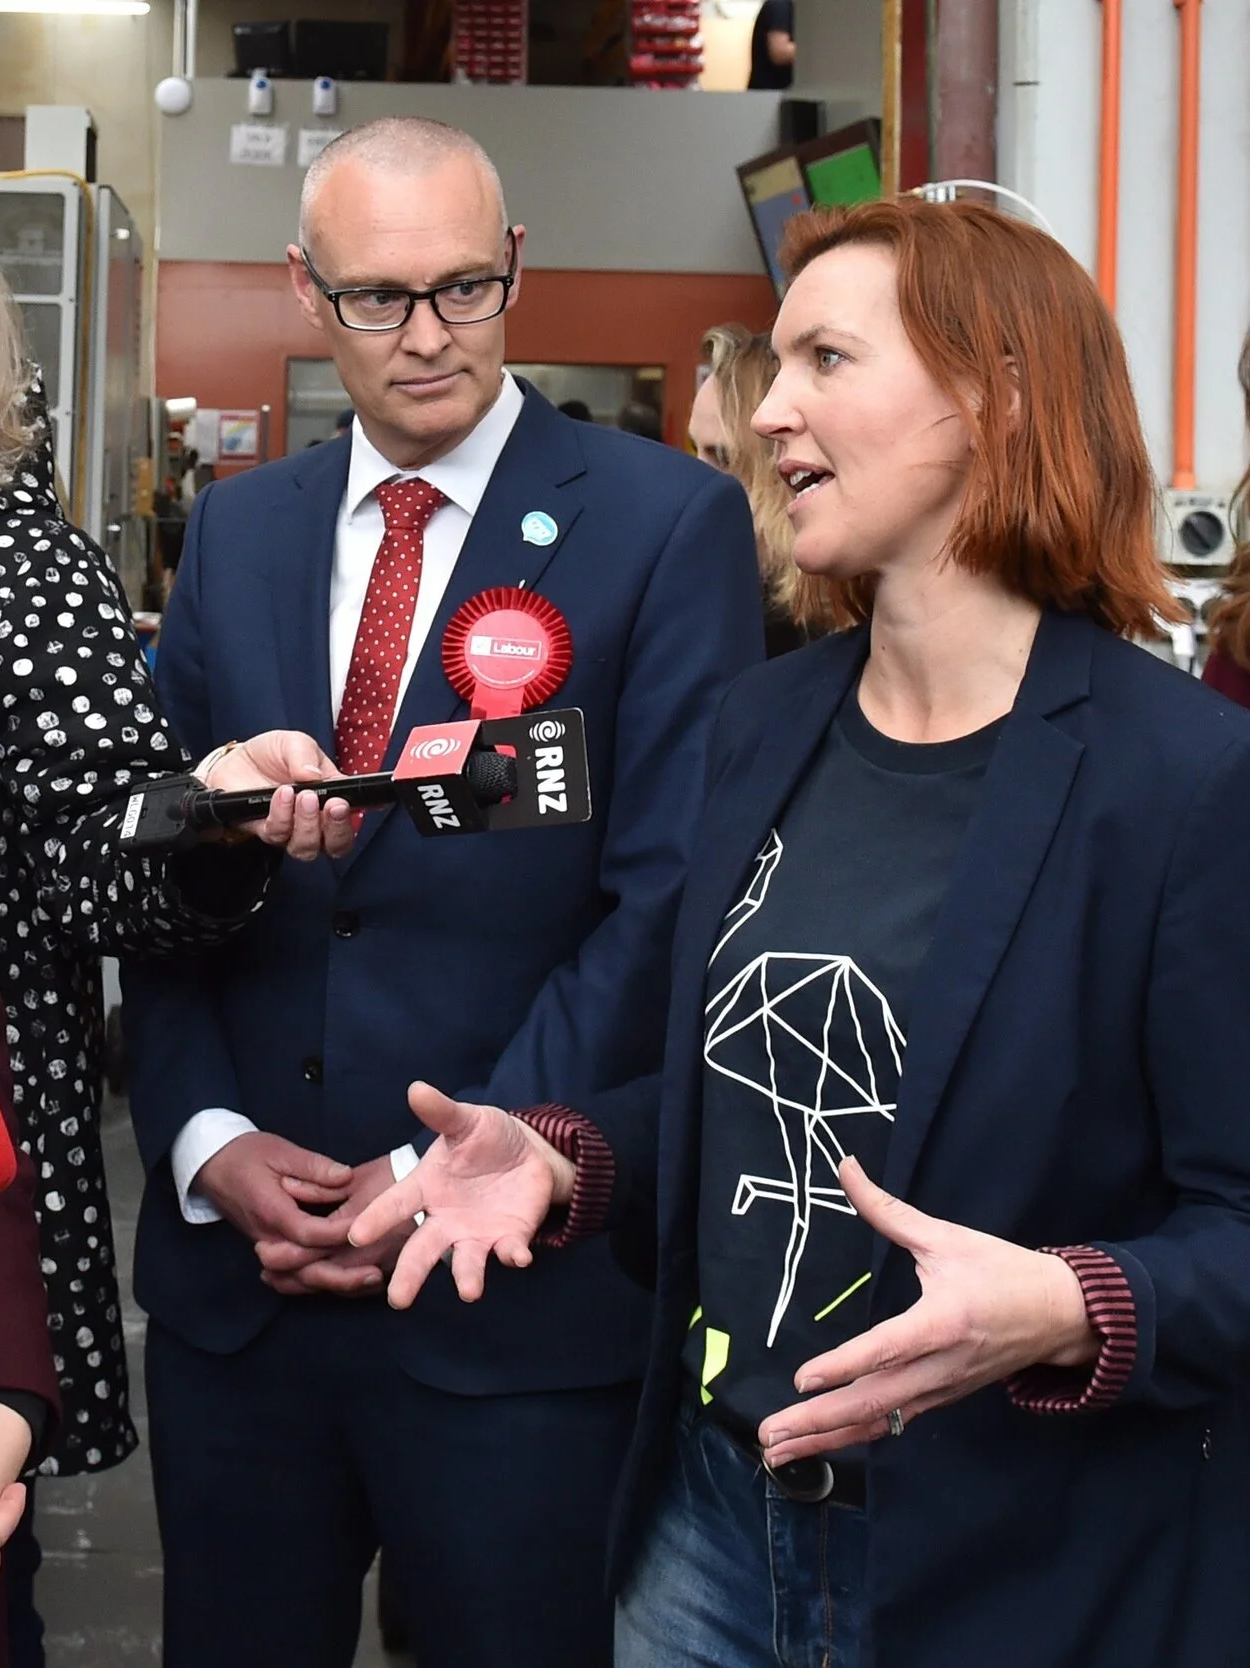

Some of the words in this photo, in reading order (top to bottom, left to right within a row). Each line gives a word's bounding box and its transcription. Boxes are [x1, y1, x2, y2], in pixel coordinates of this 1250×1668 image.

[493, 642, 537, 657] Labour
[535, 746, 568, 815] RNZ
[123, 796, 139, 837] WLG014
[417, 784, 461, 829] RNZ
